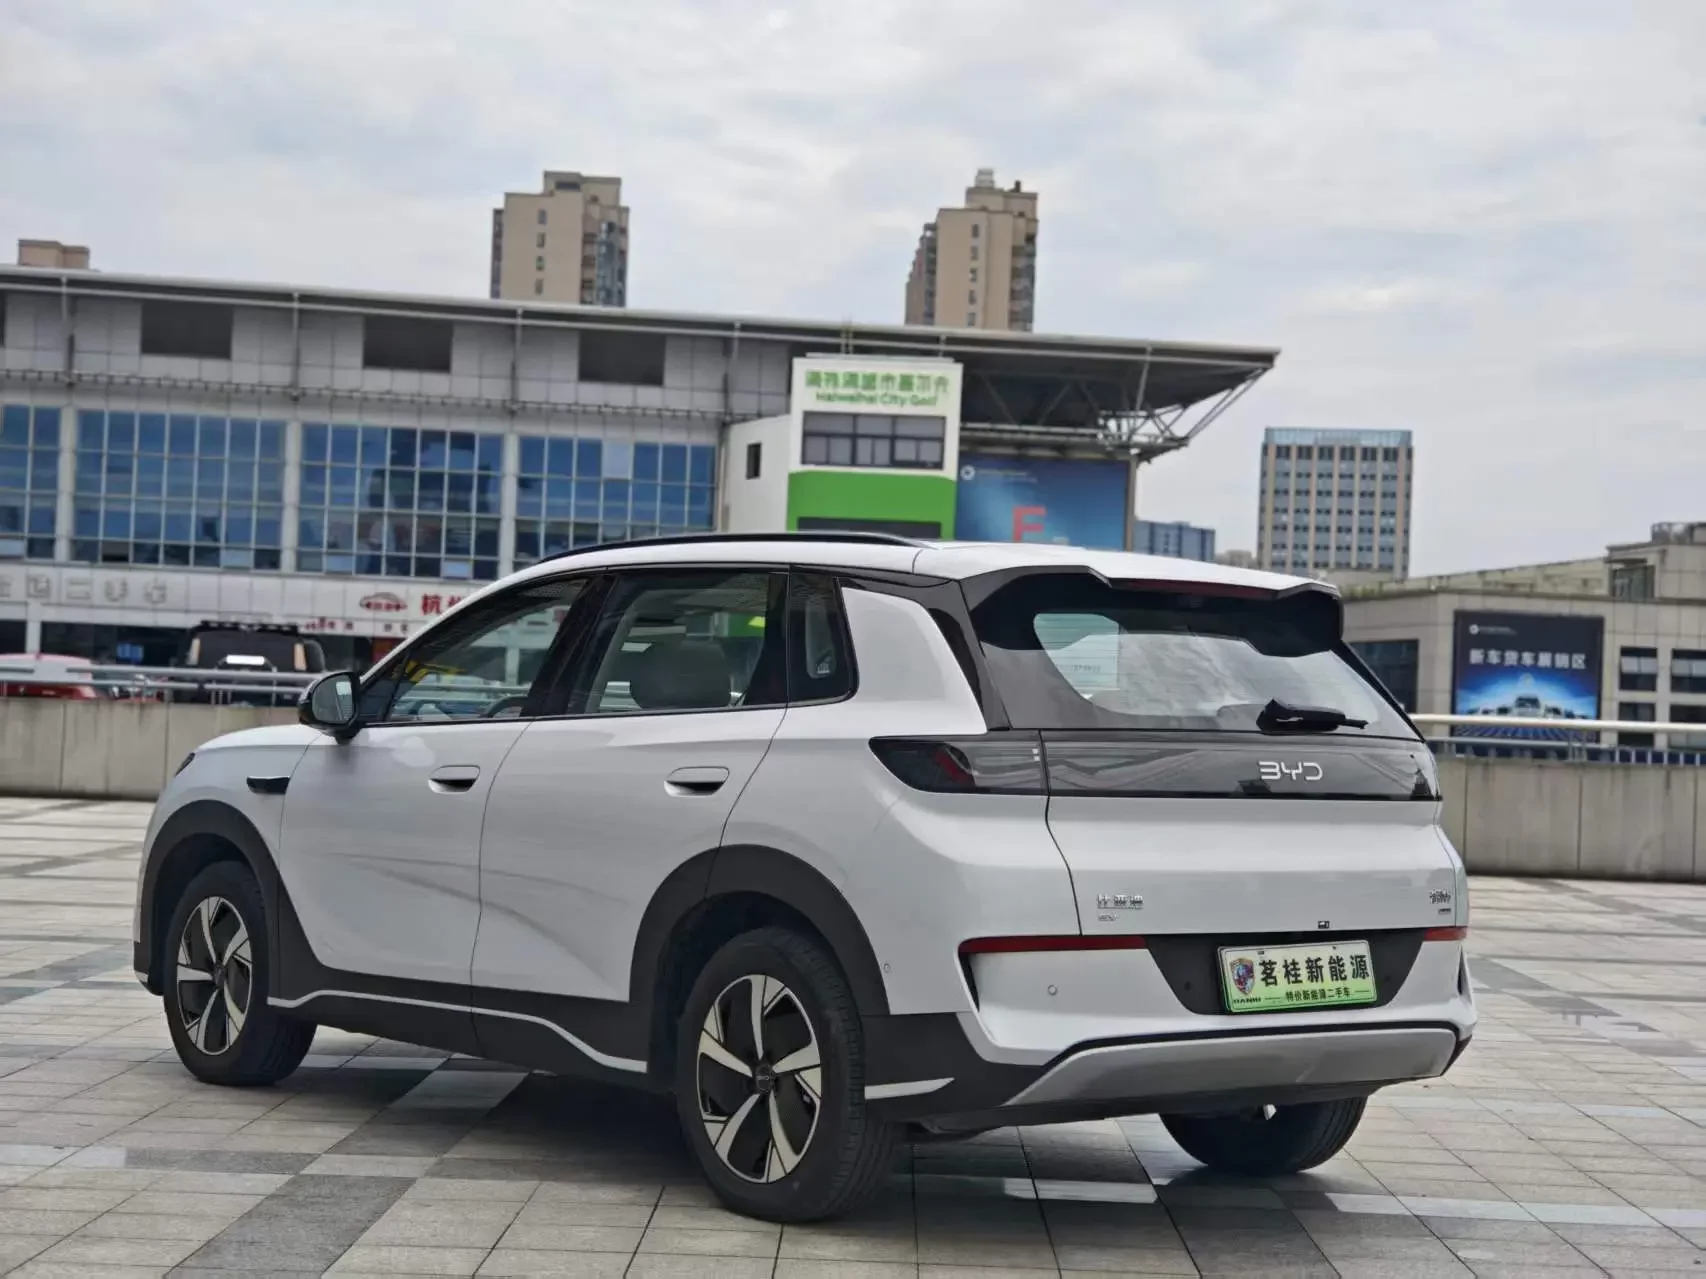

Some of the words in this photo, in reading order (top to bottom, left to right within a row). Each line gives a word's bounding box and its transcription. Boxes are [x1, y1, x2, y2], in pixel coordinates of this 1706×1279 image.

[1259, 761, 1323, 780] BYD
[1259, 955, 1370, 987] 茗桂新能源
